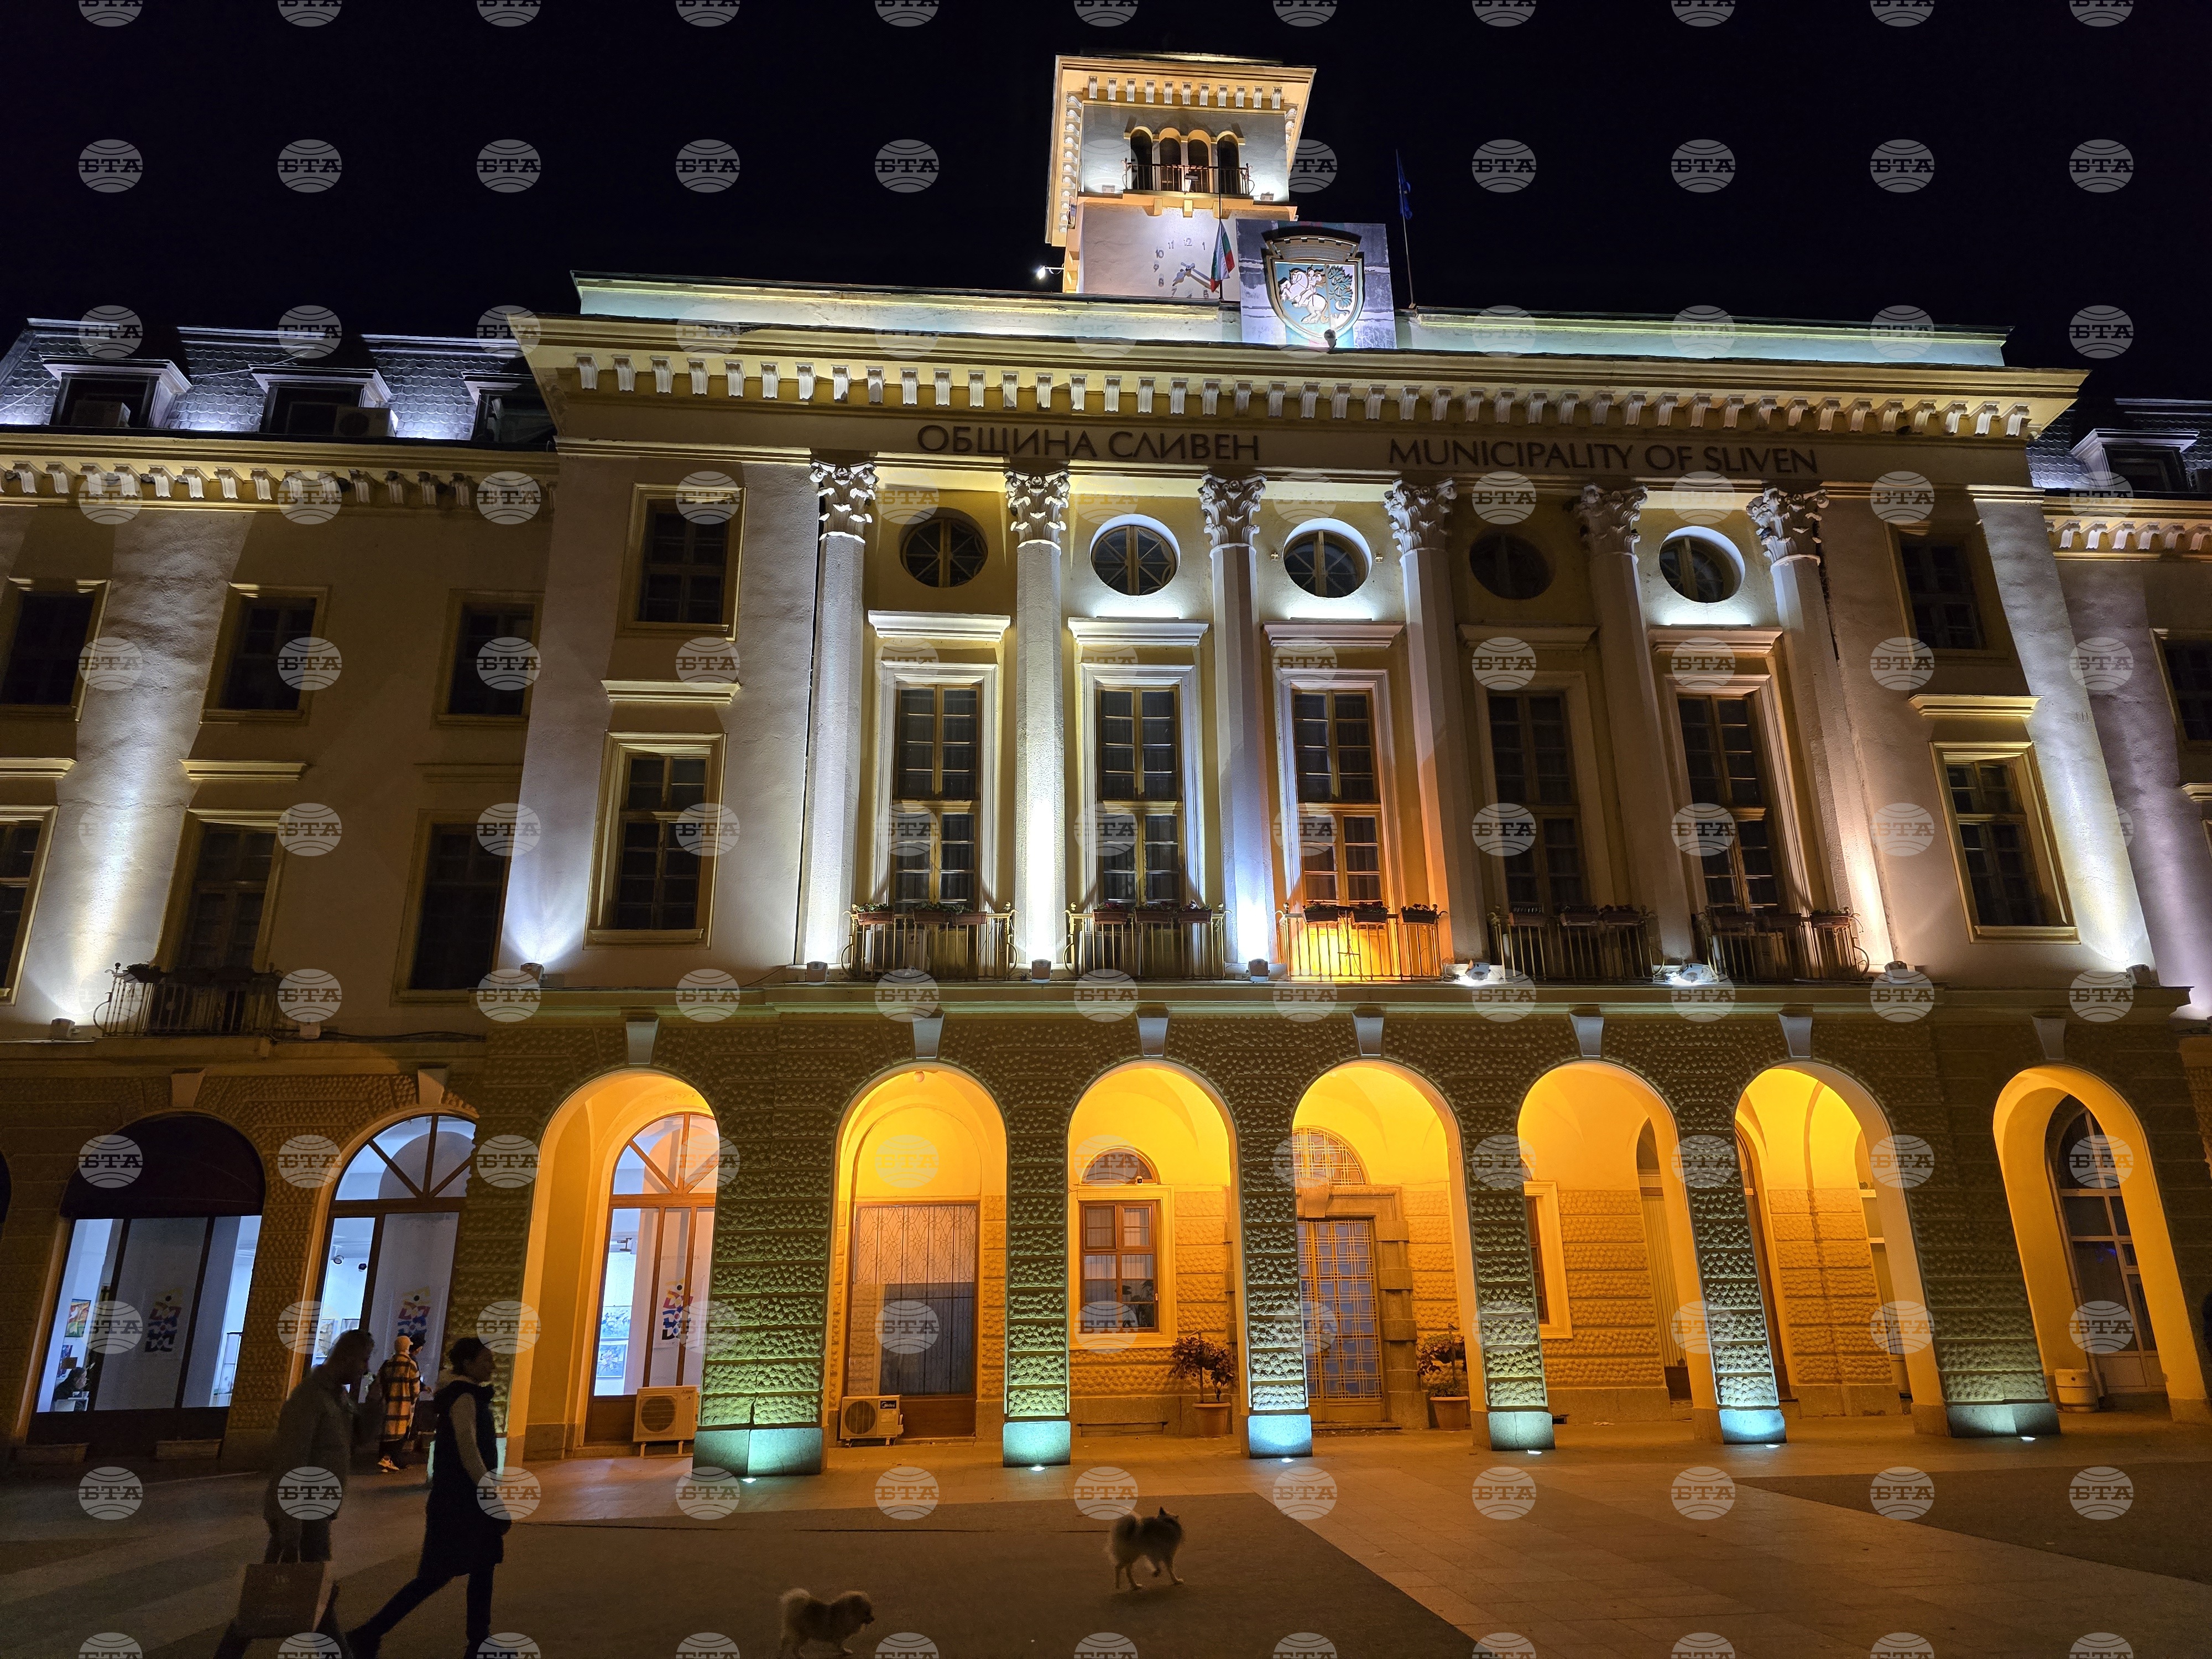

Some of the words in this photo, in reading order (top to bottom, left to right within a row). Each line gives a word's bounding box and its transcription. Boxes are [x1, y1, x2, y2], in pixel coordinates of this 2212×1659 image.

[1168, 240, 1174, 249] 11
[1183, 238, 1192, 246] 12
[1155, 249, 1164, 258] 10
[917, 425, 1097, 458] ОБЩИНА
[1108, 430, 1259, 461] СЛИВЕН
[1389, 438, 1633, 469] MUNICIPALITY
[1645, 444, 1693, 471] OF
[1702, 445, 1819, 474] SLIVEN
